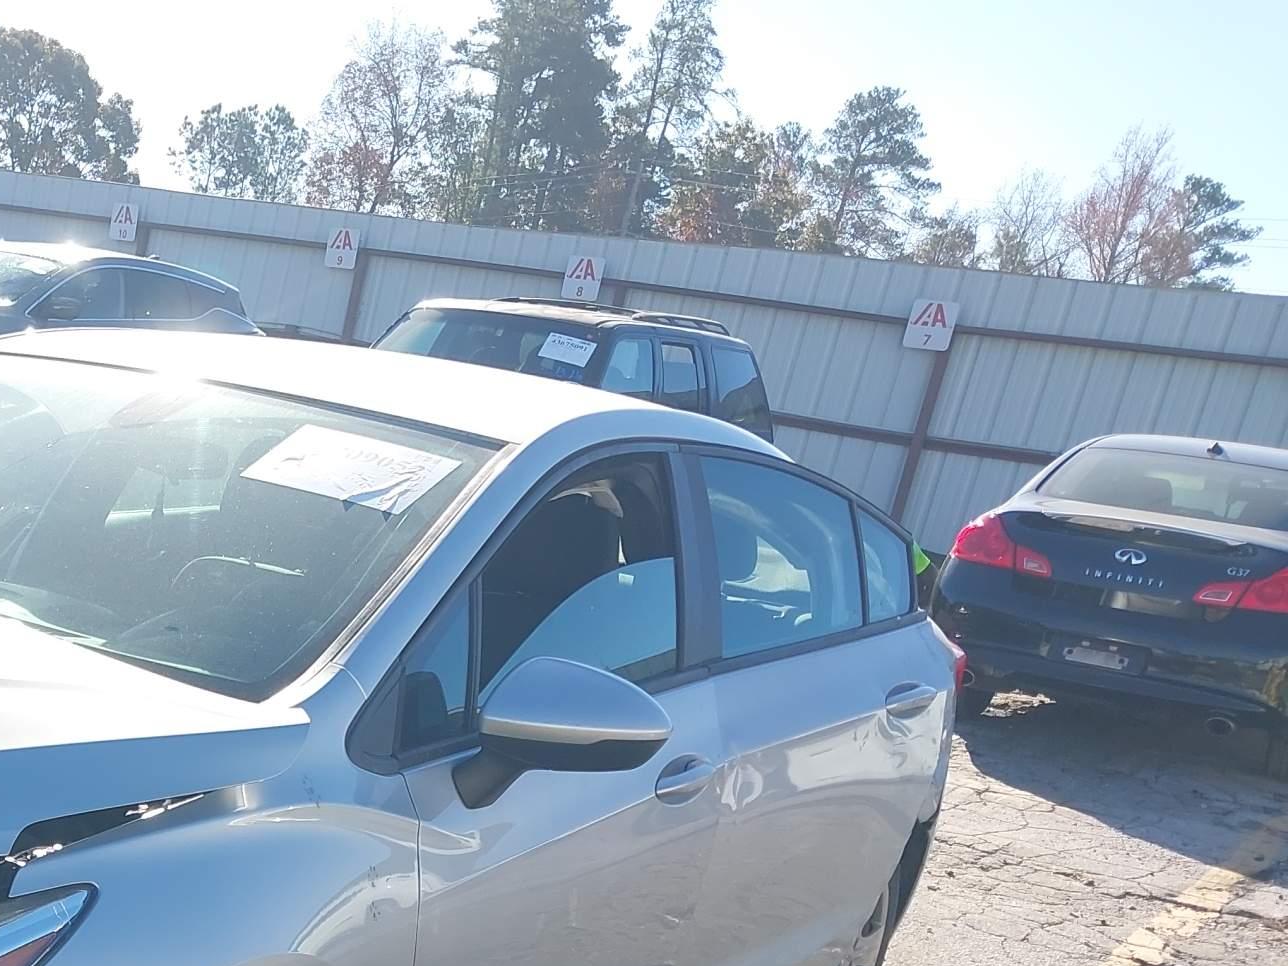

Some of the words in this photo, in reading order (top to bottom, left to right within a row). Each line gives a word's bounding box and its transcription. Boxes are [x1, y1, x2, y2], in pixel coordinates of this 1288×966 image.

[119, 229, 127, 239] 10
[336, 255, 343, 266] 9
[576, 286, 584, 297] 8
[923, 334, 932, 346] 7
[1227, 566, 1251, 577] G37
[1085, 567, 1164, 588] INFINITI
